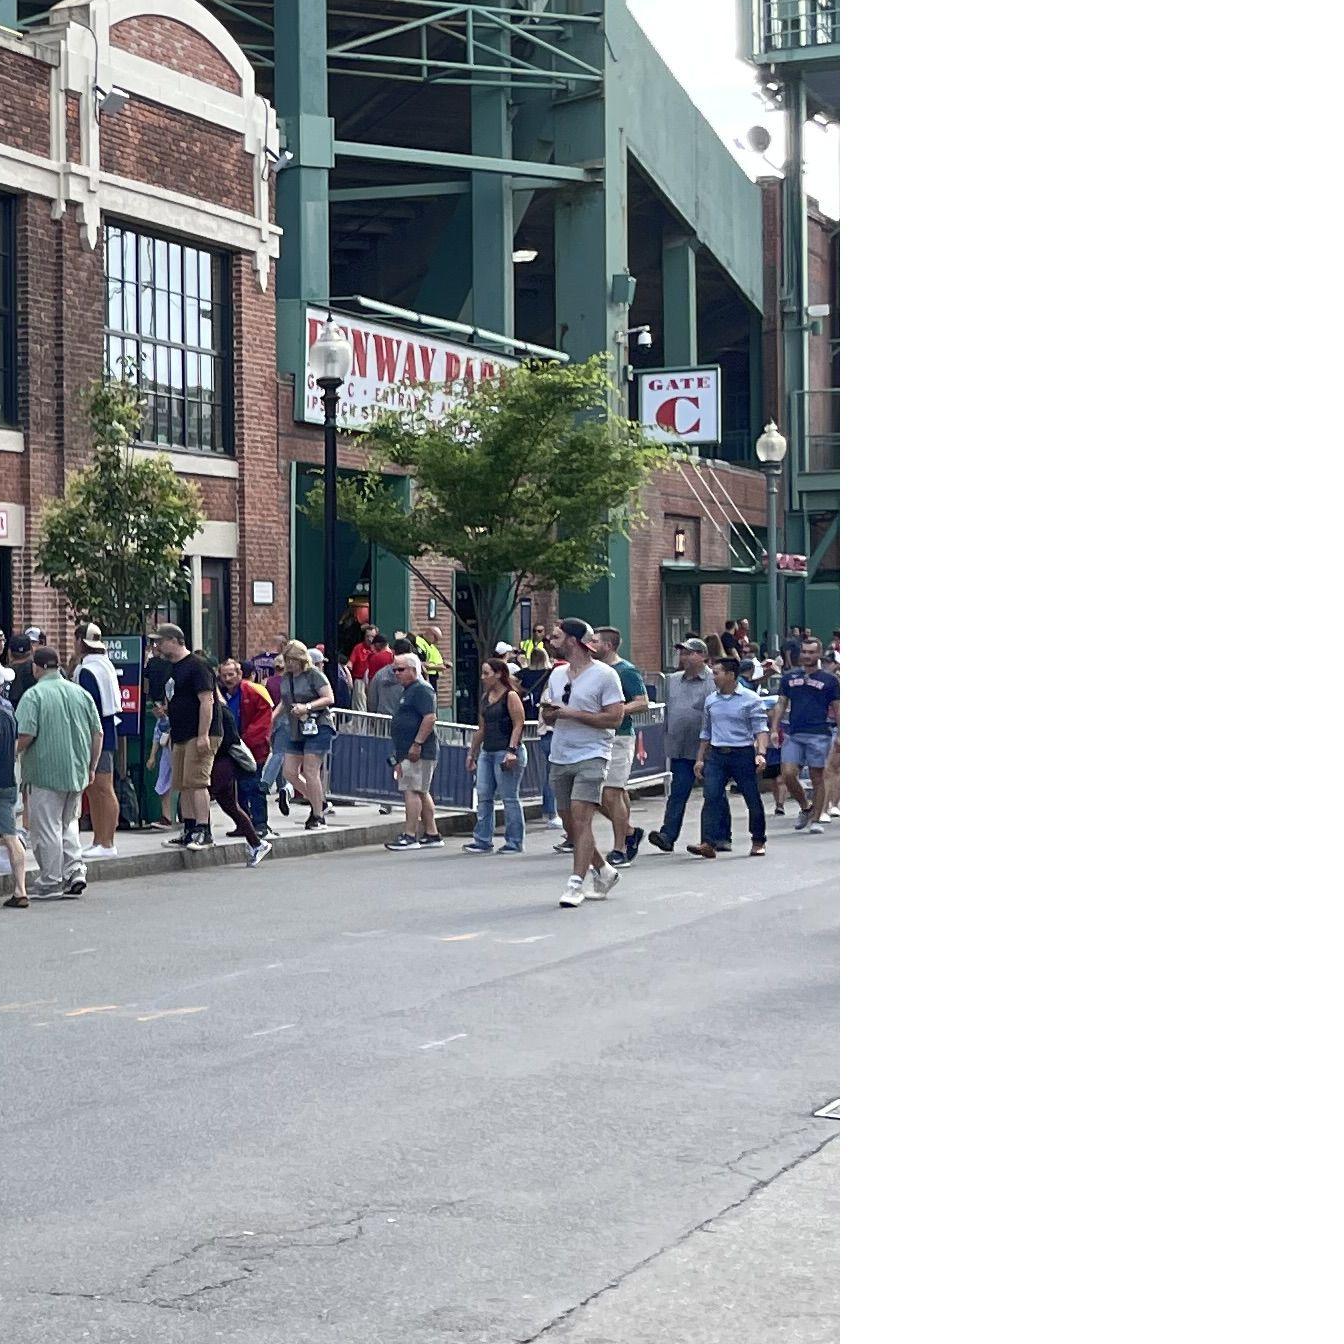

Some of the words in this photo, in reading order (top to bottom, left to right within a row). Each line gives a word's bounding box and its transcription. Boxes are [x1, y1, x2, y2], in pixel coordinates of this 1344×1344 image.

[308, 318, 437, 389] NWAY
[648, 376, 711, 391] GATE
[307, 394, 357, 417] IPSICH
[656, 396, 700, 434] C
[108, 650, 128, 660] ECK
